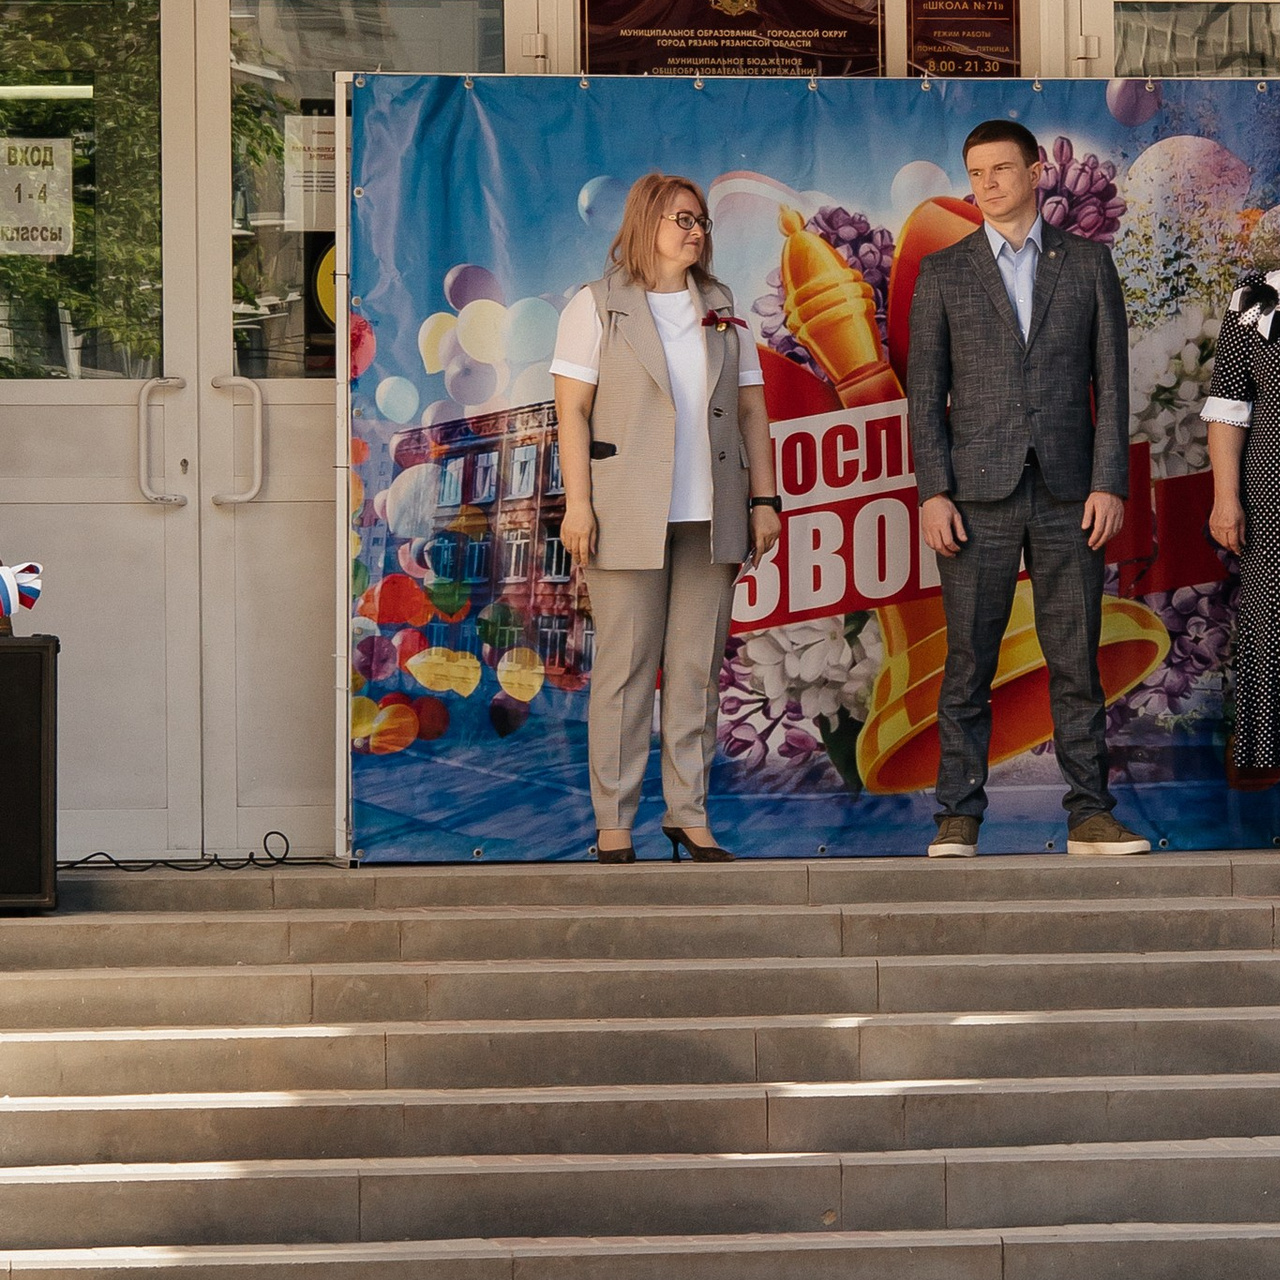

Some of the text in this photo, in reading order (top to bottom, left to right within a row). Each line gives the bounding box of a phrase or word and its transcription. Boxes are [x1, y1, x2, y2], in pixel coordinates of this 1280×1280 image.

[923, 1, 969, 10] «ШКОЛА
[619, 29, 695, 37] МУНИЦИПАЛЬНОЕ
[697, 29, 757, 37] ОБРАЗОВАНИЕ
[767, 29, 820, 38] ГОРОДСКОЙ
[821, 30, 848, 38] ОКРУГ
[657, 38, 812, 48] ГОРОД РЯЗАНЬ РЯЗАНСКОЙ ОБЛАСТИ
[667, 57, 803, 66] МУНИЦИПАЛЬНОЕ БЮДЖЕТНОЕ
[928, 61, 956, 72] 8.00
[964, 61, 1000, 72] 21.30
[651, 67, 818, 76] ОБЩЕОБРАЗОВАТЕЛЬНОЕ УЧРЕЖДЕНИЕ
[7, 146, 55, 171] ВХОД
